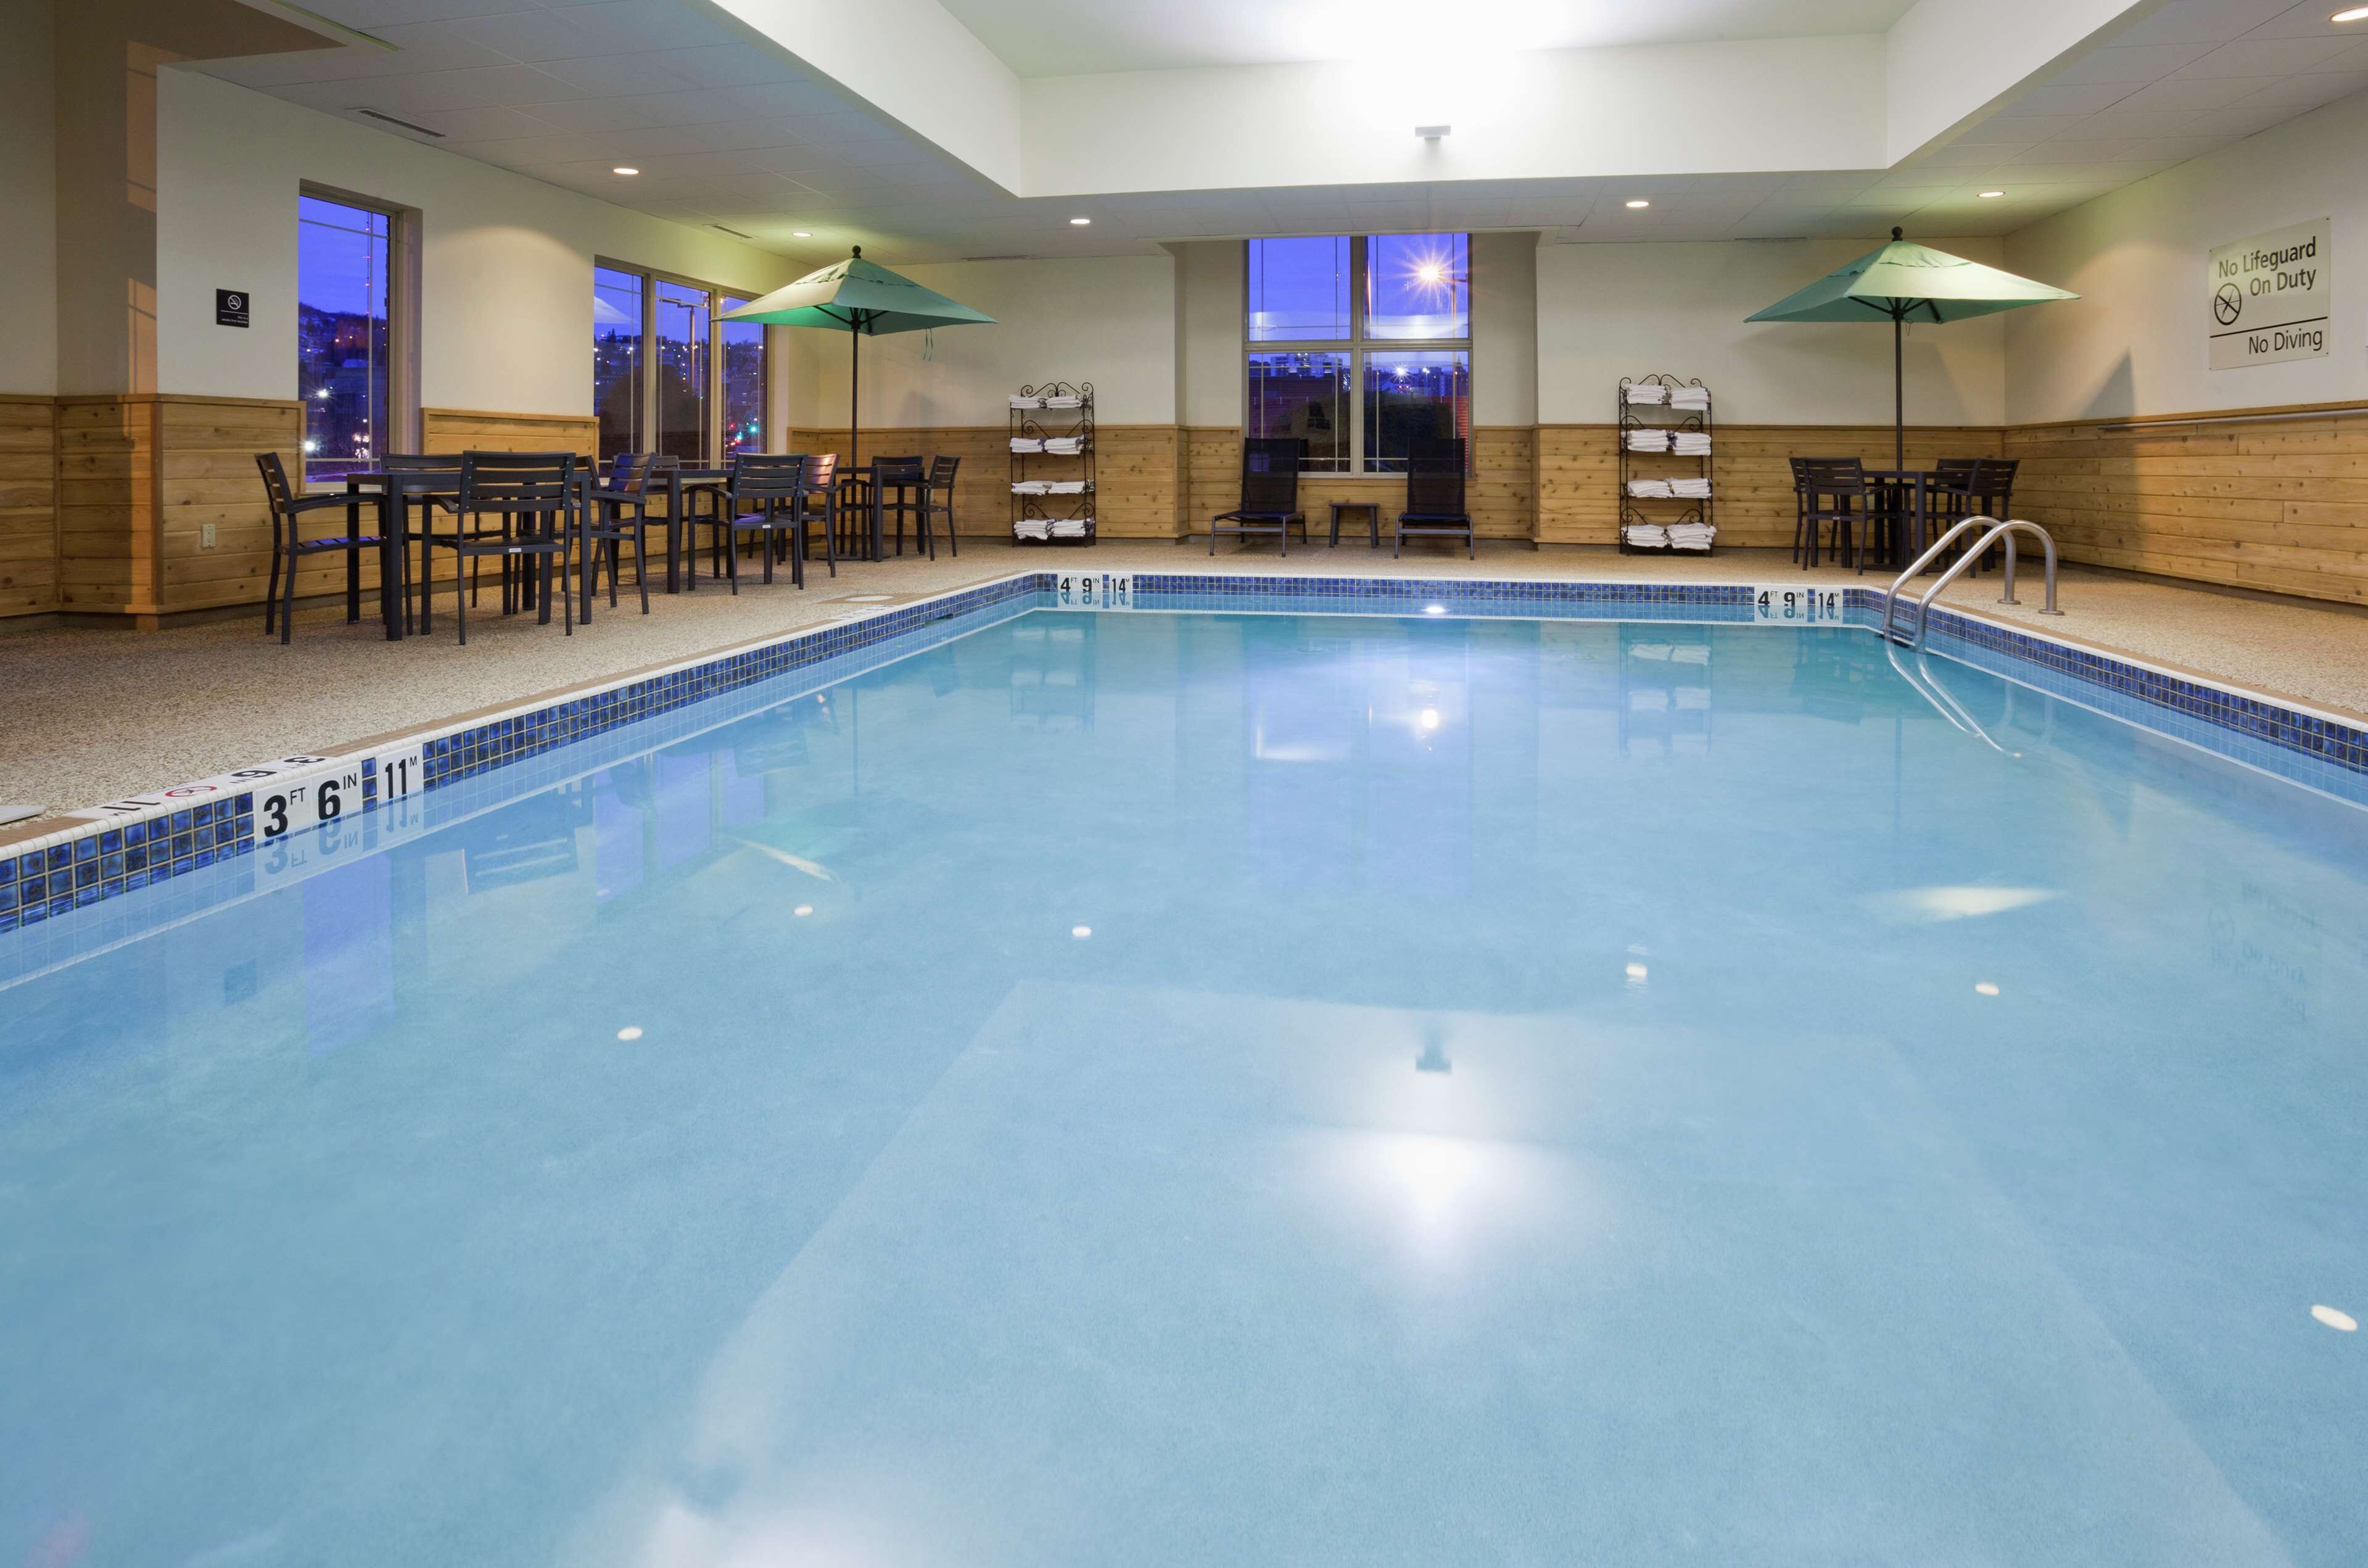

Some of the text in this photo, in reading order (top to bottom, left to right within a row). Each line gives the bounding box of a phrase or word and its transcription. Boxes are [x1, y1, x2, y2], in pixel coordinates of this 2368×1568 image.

[2219, 236, 2316, 278] No Lifeguard
[2250, 268, 2317, 296] On Duty
[2249, 328, 2323, 355] No Diving
[1060, 577, 1071, 593] 4
[1082, 577, 1092, 593] 9
[1758, 591, 1770, 606] 4
[1784, 592, 1796, 606] 9
[264, 794, 289, 838] 3
[291, 787, 306, 805] FT
[318, 780, 340, 820] 6
[343, 772, 357, 790] IN
[410, 756, 418, 766] M
